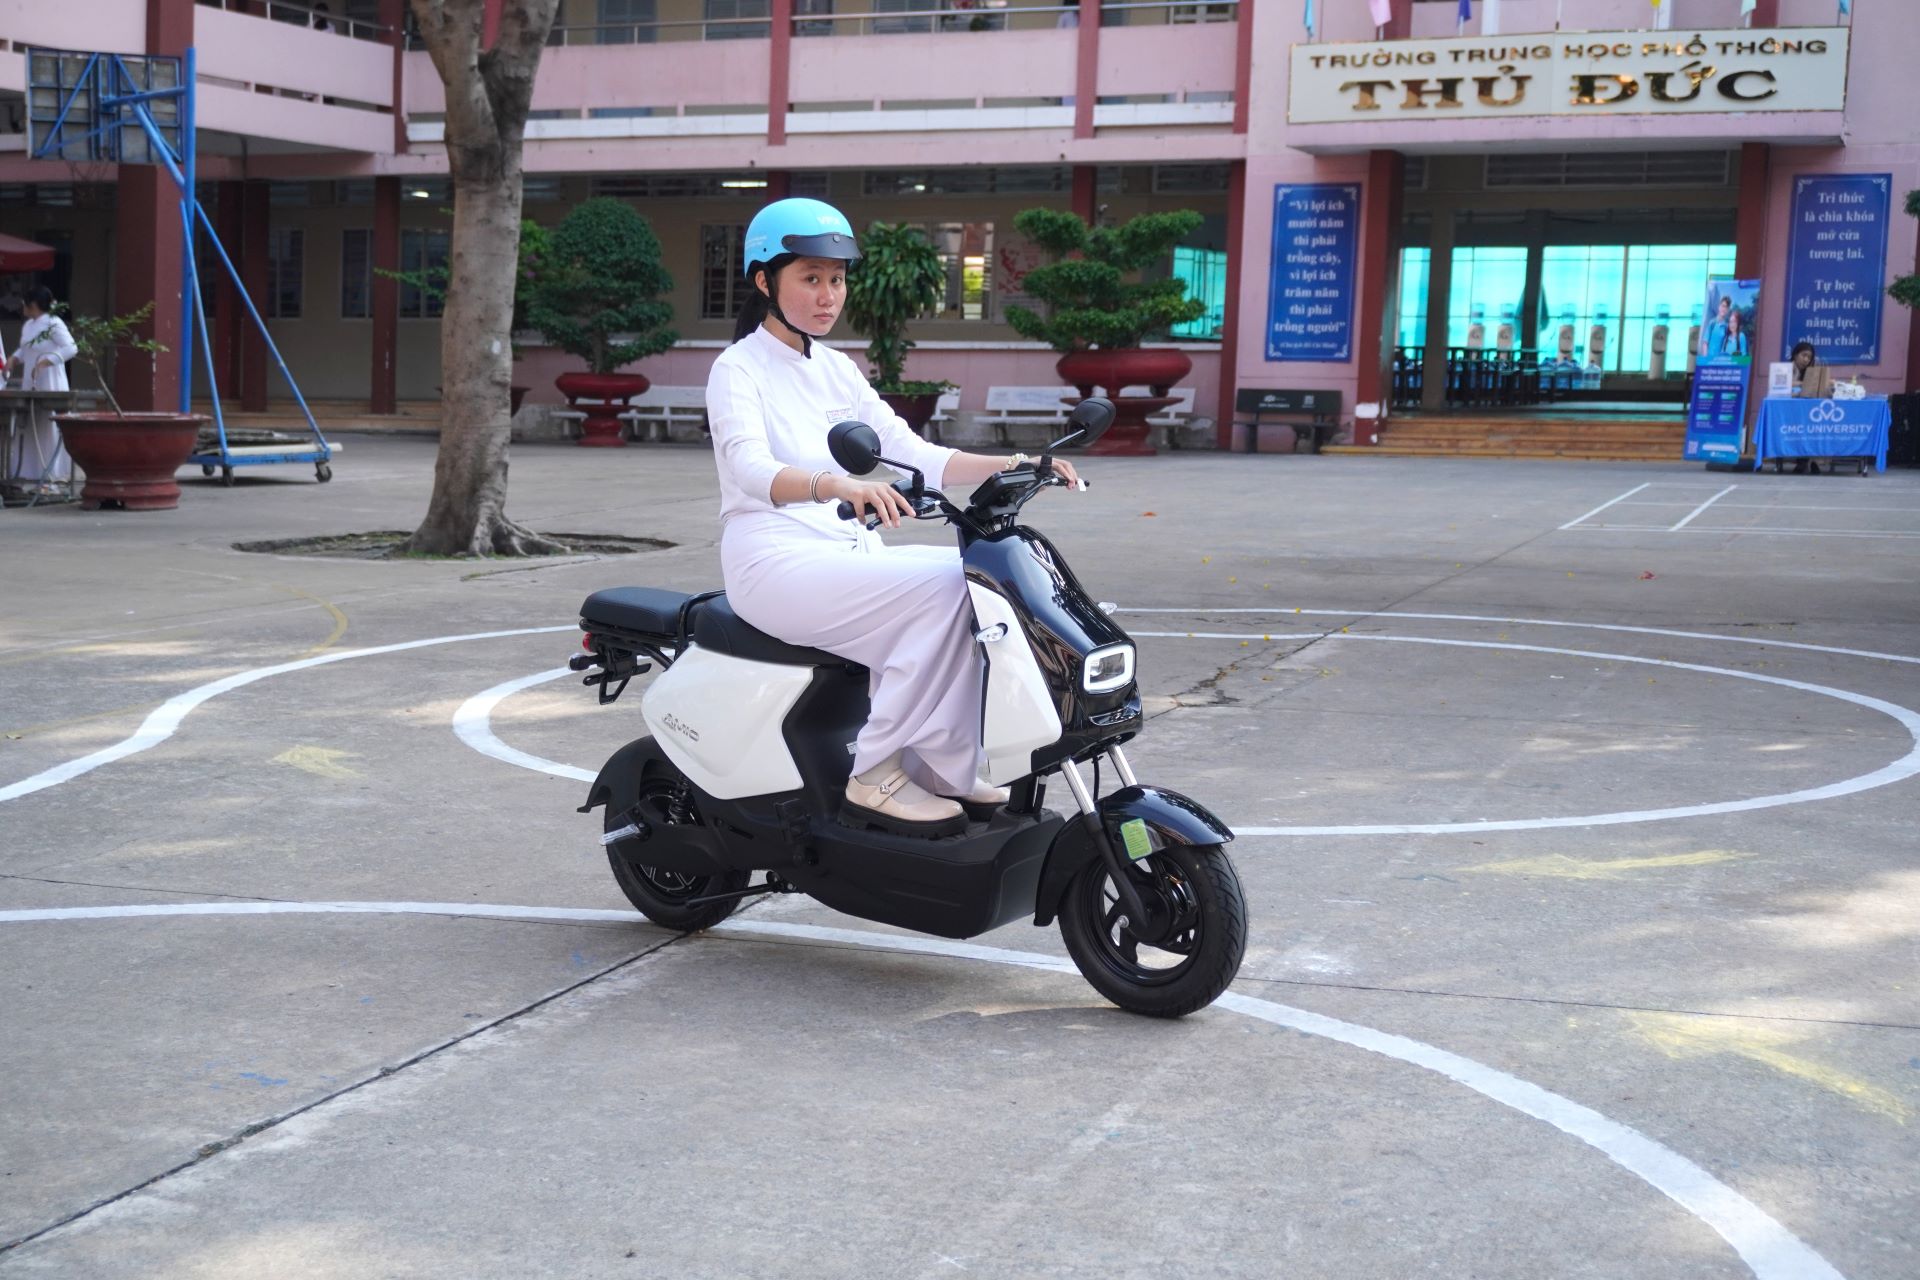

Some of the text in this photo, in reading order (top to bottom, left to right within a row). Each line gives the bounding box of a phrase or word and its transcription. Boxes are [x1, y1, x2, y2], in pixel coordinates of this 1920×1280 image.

[1310, 34, 1828, 69] TRƯỜNG TRUNG HỌC PHỔ THÔNG
[1339, 60, 1778, 111] THỦ ĐỨC
[1838, 192, 1865, 204] thức
[1804, 210, 1815, 222] là
[1846, 210, 1875, 222] khóa
[1809, 247, 1864, 261] tương lai.
[1814, 279, 1856, 293] Tự học
[1813, 297, 1839, 312] phát
[1842, 296, 1871, 309] triển
[1805, 317, 1835, 330] năng
[1834, 332, 1863, 346] chất.
[1780, 424, 1873, 434] CMC UNIVERSITY
